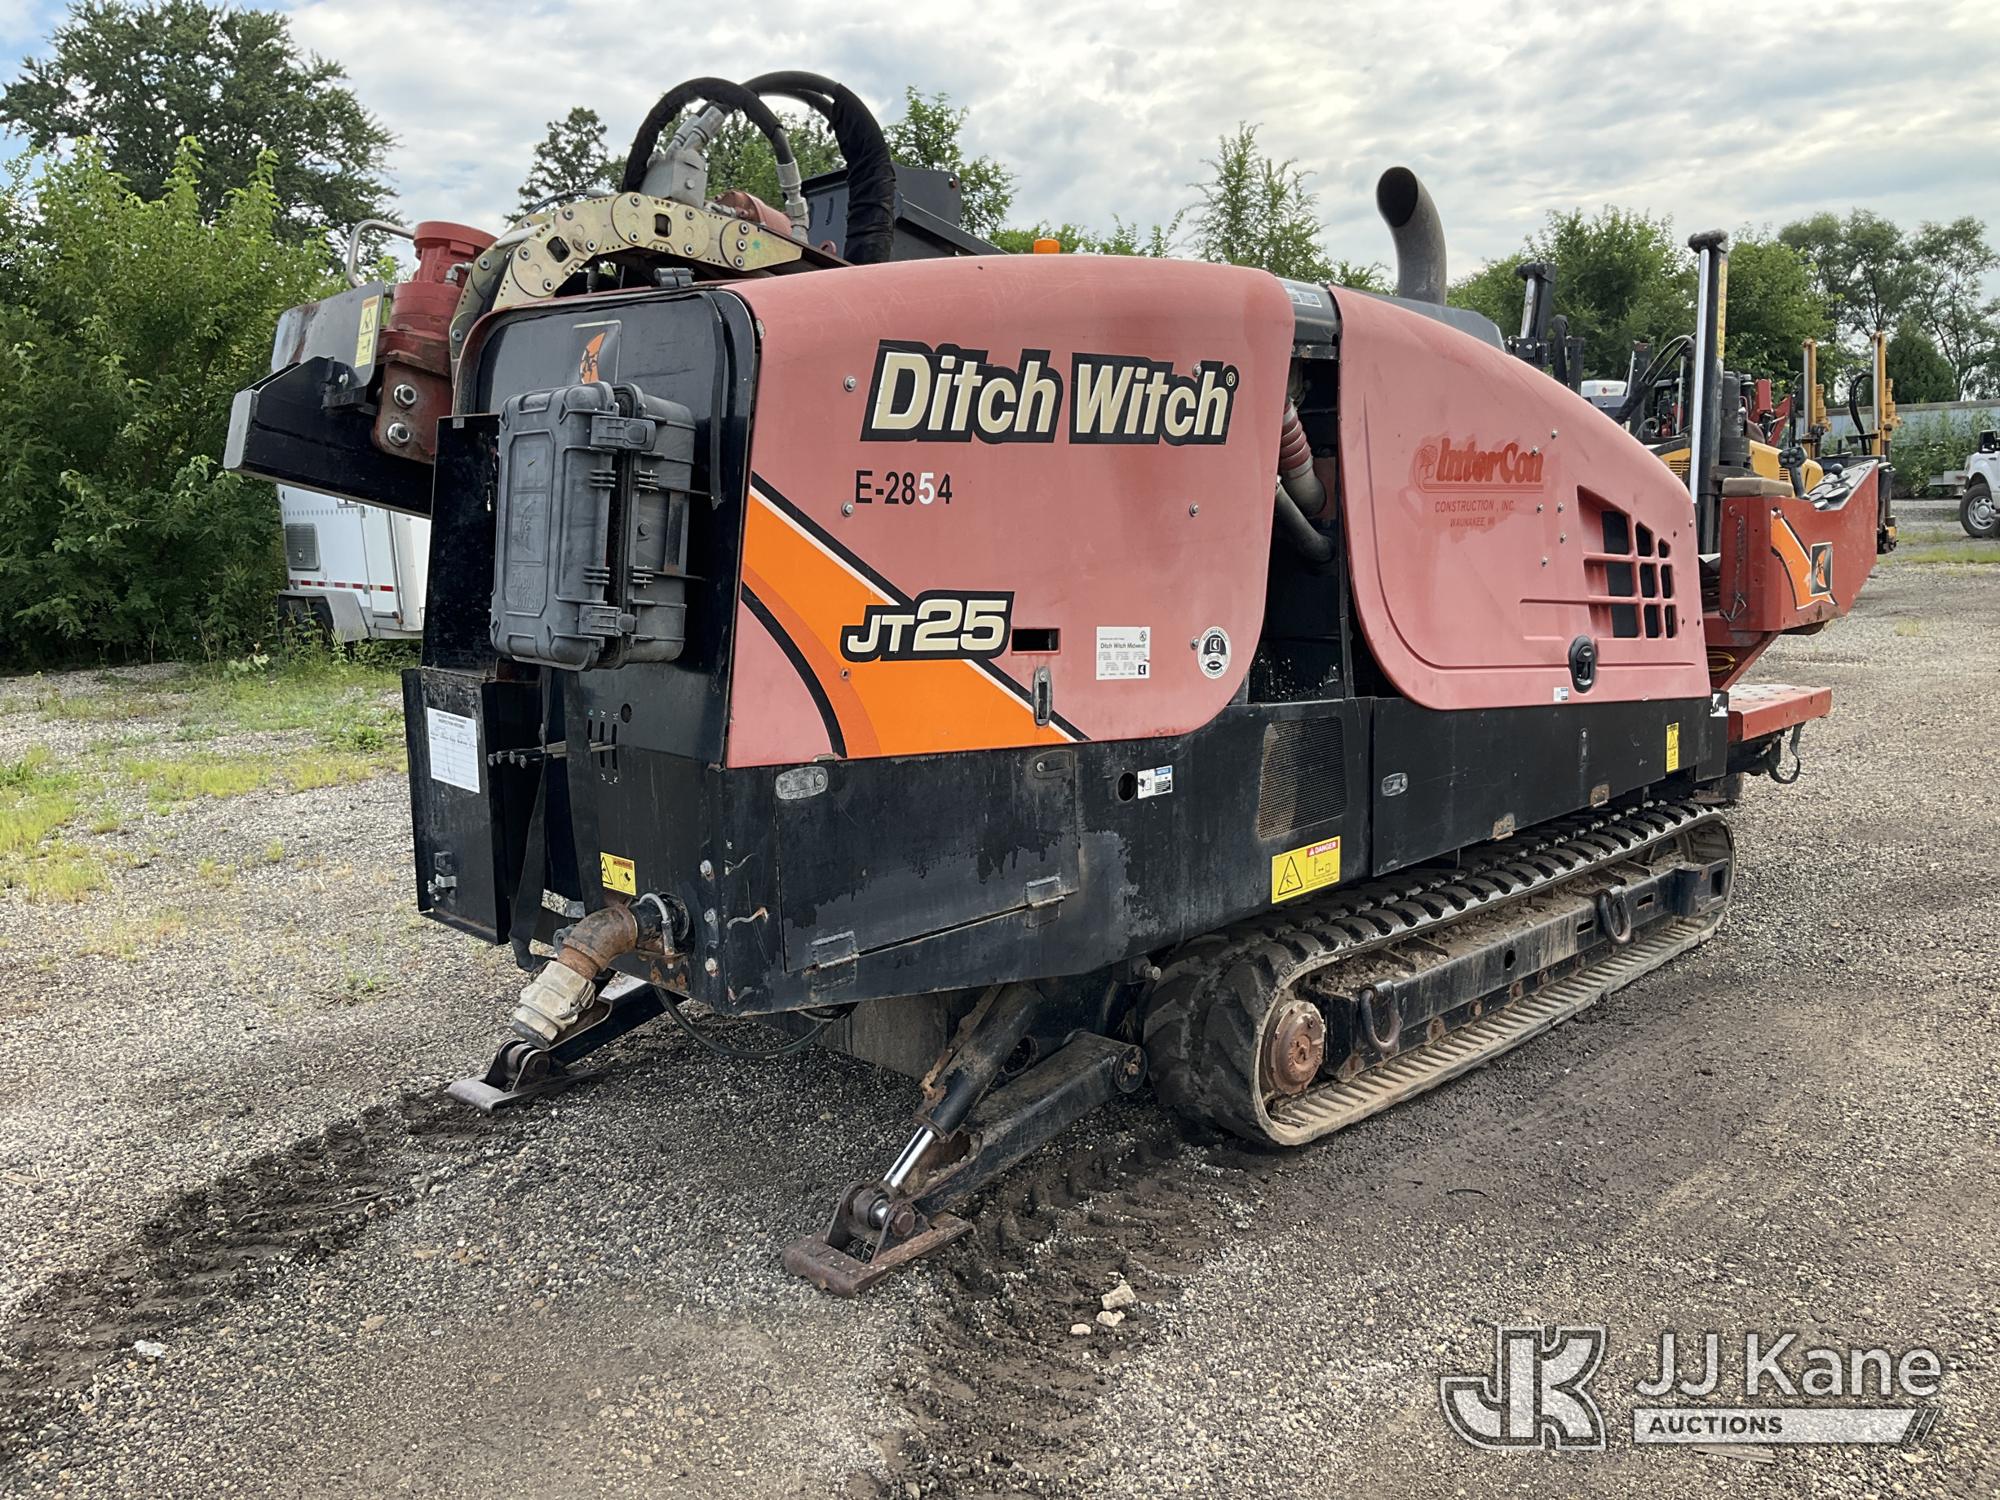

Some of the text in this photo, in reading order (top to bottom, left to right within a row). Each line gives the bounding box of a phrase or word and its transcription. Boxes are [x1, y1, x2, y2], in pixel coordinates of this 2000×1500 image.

[870, 350, 1057, 434] Ditch
[1436, 437, 1544, 483] InterCon
[855, 470, 953, 505] E-2854
[847, 599, 1008, 652] JT25
[1314, 841, 1337, 855] DANGER
